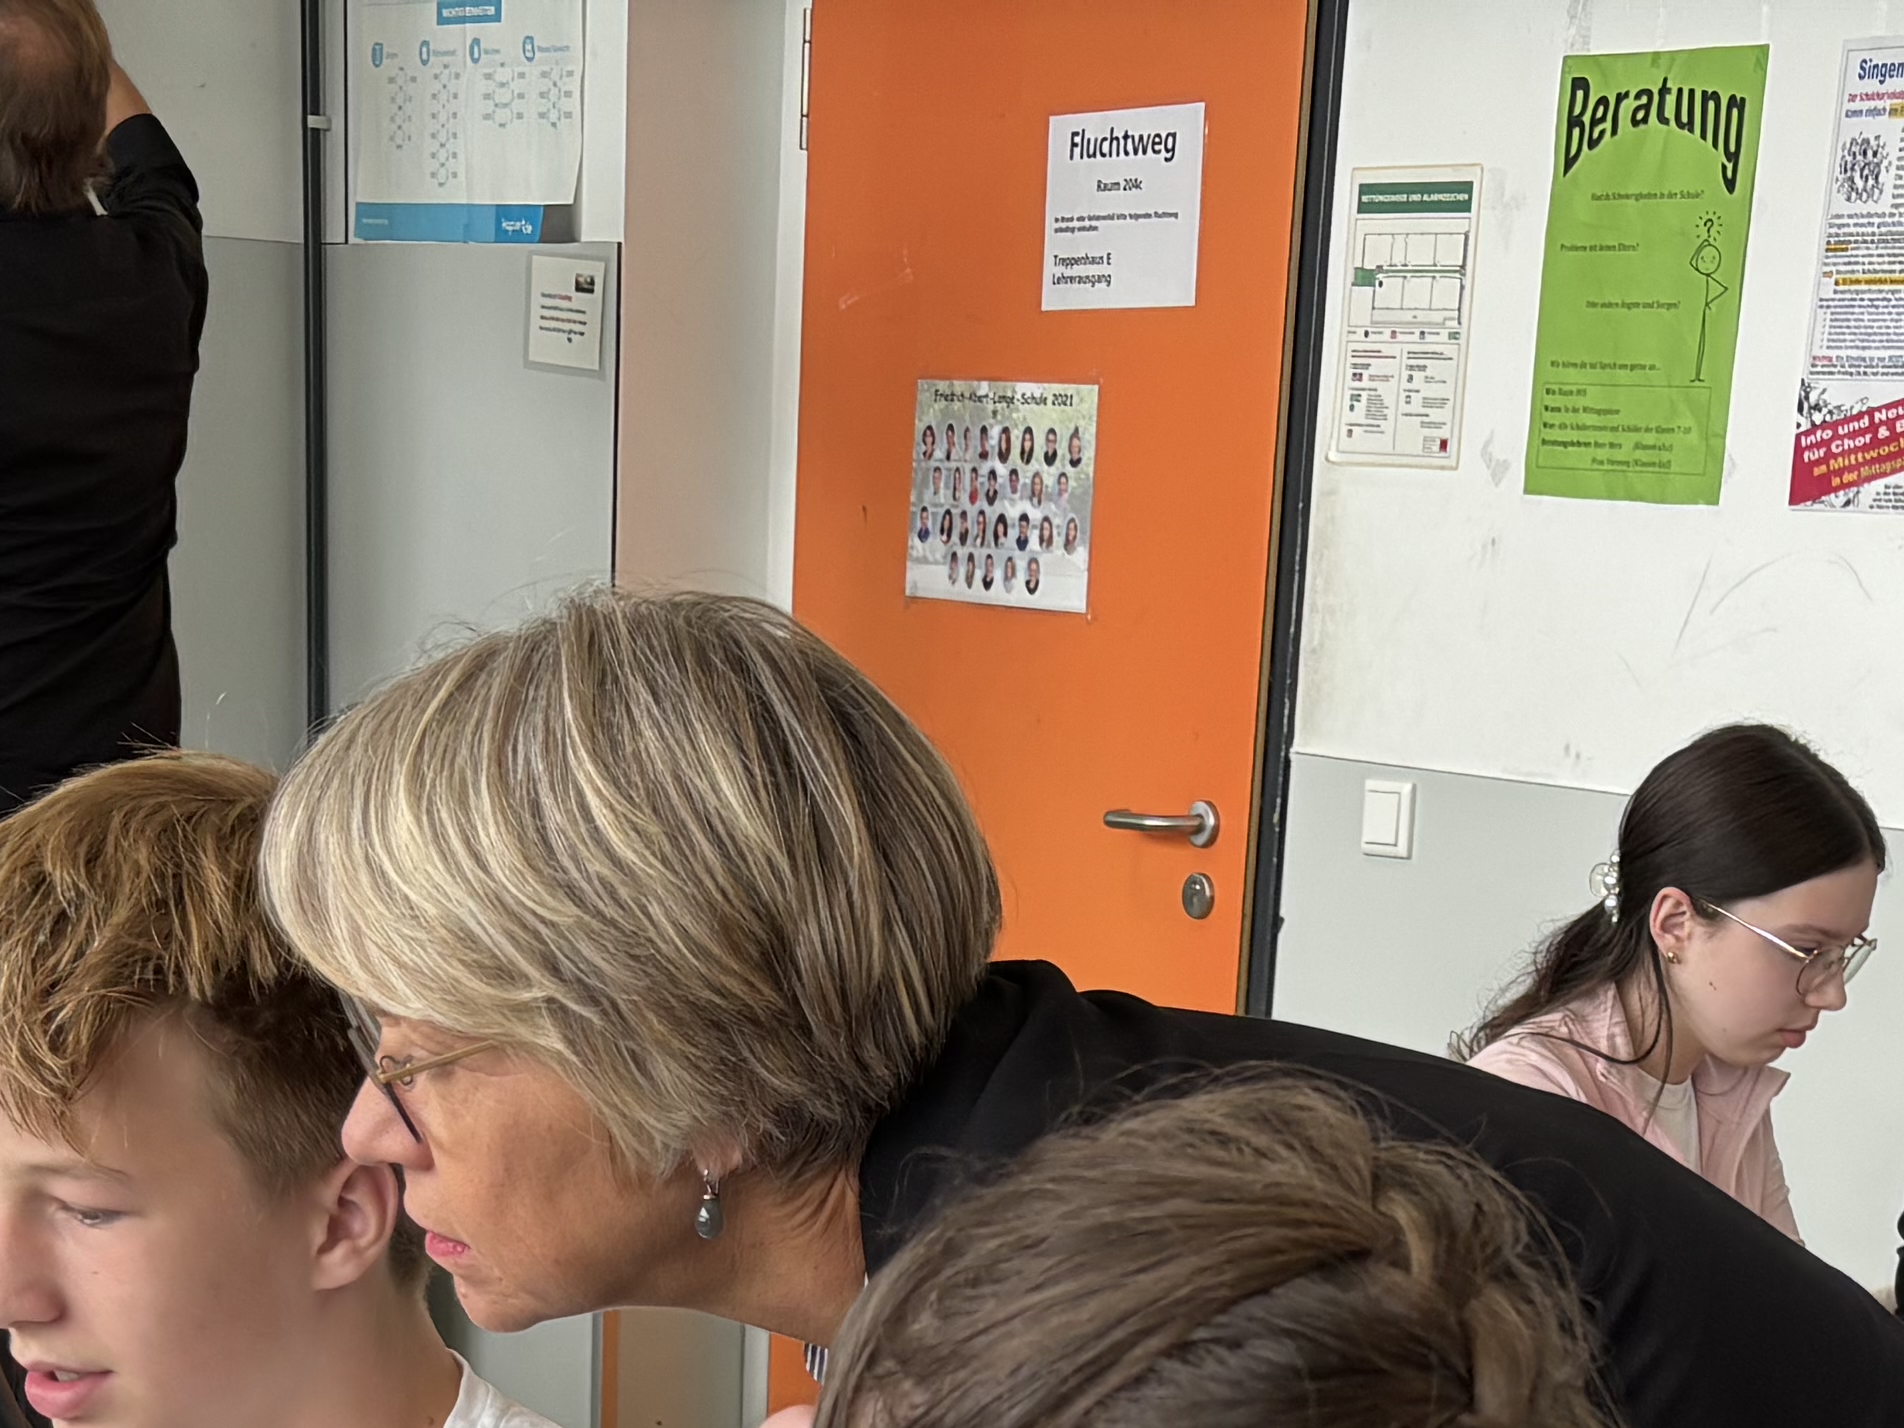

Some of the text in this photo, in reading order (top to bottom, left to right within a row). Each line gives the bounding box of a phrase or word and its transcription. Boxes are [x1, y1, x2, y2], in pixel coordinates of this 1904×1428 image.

[1858, 58, 1904, 85] Singen
[1069, 126, 1177, 163] Fluchtweg
[1563, 77, 1746, 195] Beratung
[1097, 180, 1120, 192] Raum
[1054, 253, 1104, 269] Treppenhaus
[1053, 272, 1111, 288] Lehrerausgang
[1801, 431, 1833, 448] Info
[1838, 416, 1869, 434] und
[1803, 450, 1827, 463] für
[1831, 433, 1872, 454] Chor
[1878, 426, 1889, 439] &
